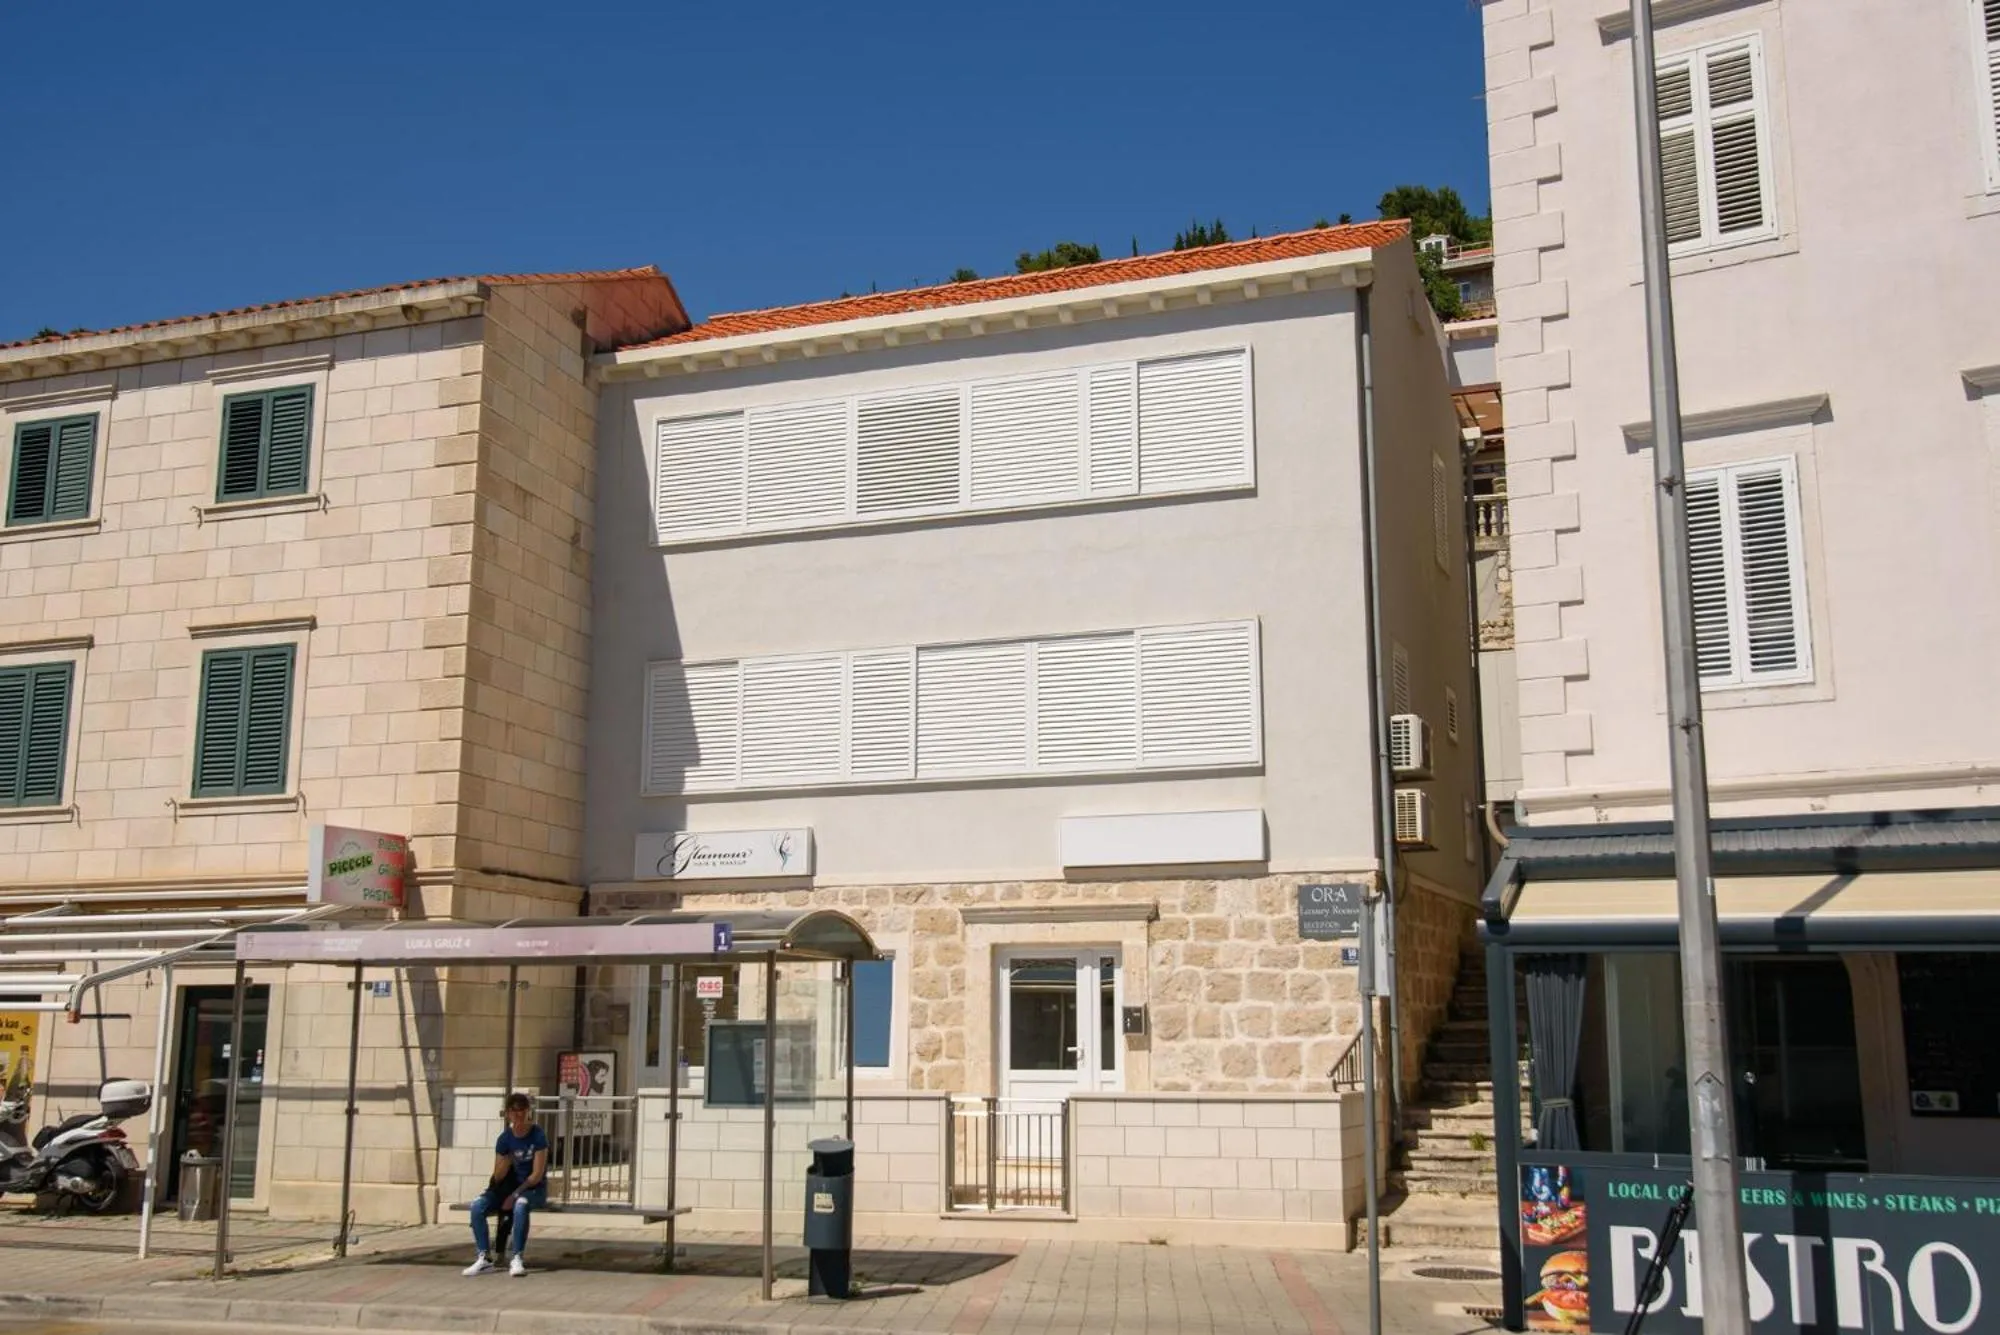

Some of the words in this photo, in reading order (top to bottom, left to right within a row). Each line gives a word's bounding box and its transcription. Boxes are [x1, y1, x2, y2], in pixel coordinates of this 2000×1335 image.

[657, 833, 753, 877] Glamour
[1311, 887, 1348, 902] ORA
[405, 938, 432, 949] LUKA
[718, 931, 725, 945] 1
[1608, 1182, 1662, 1200] LOCAL
[1741, 1188, 1787, 1206] EERS
[1811, 1191, 1868, 1209] WINES
[1885, 1194, 1957, 1213] STEAKS
